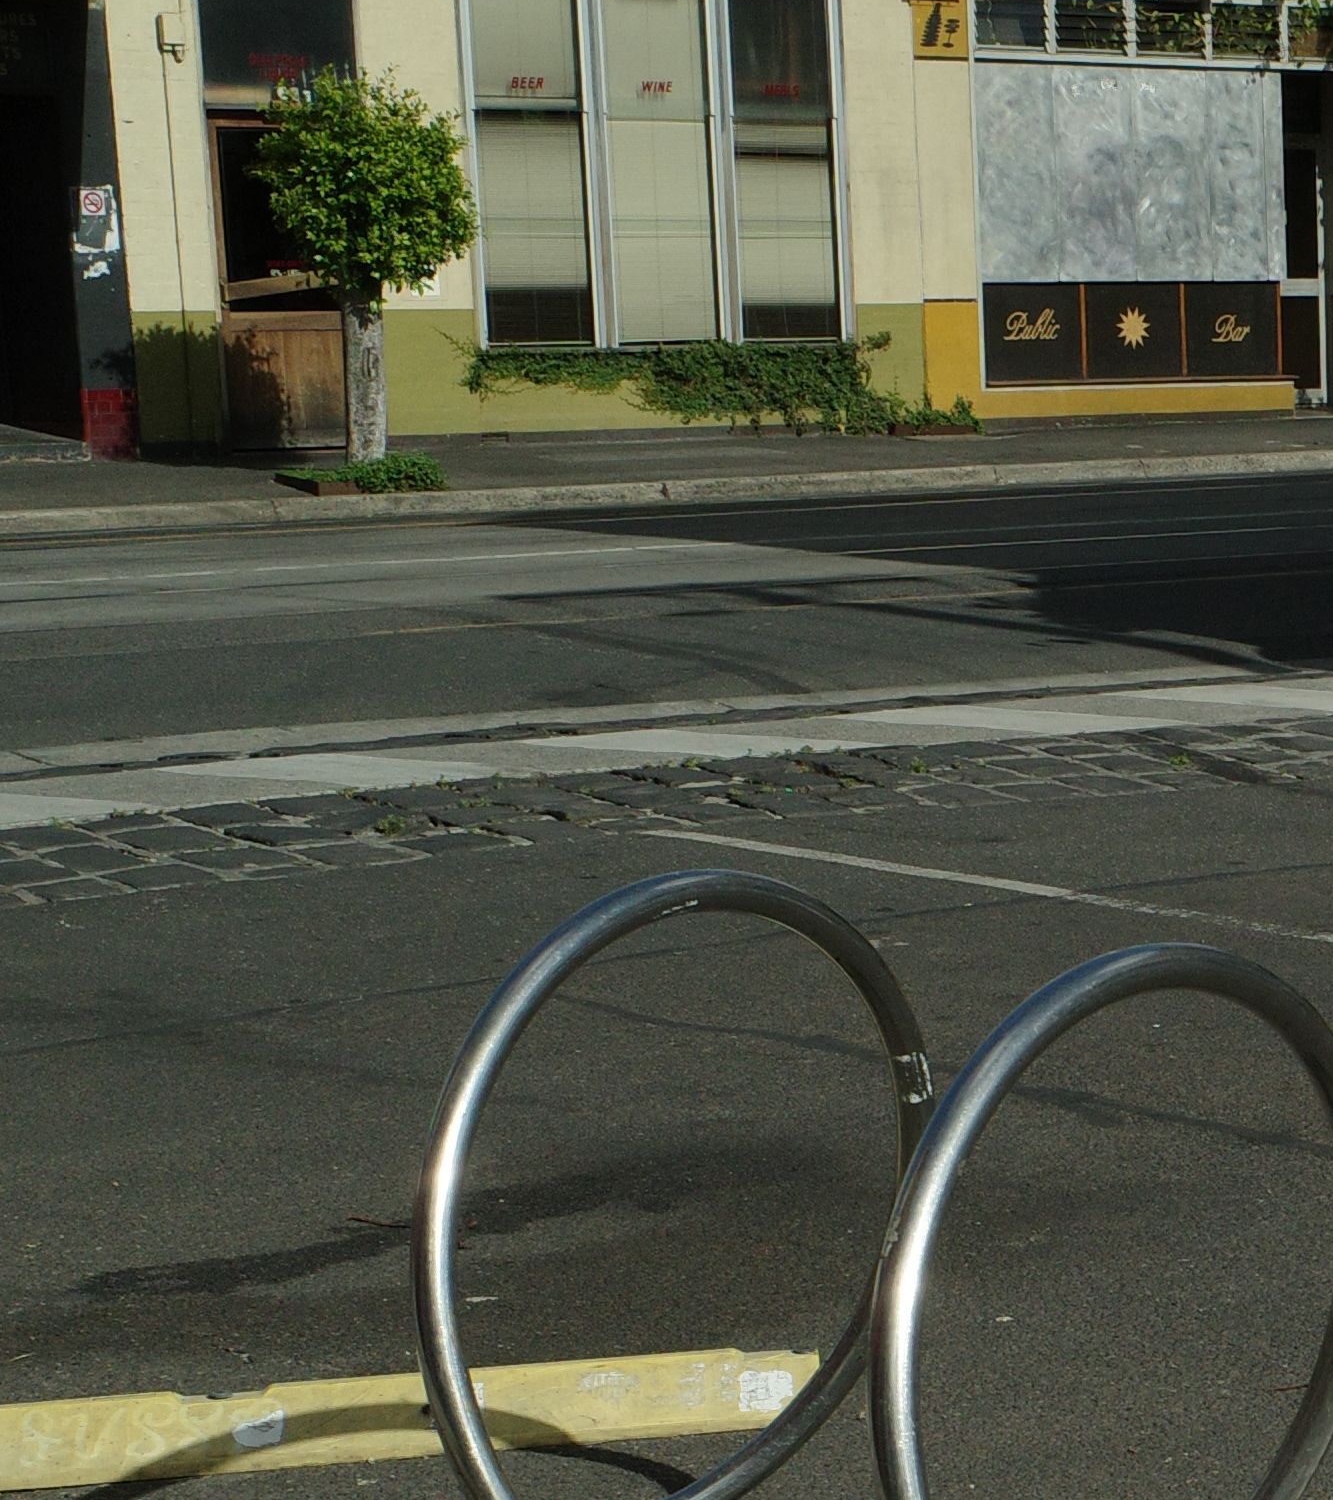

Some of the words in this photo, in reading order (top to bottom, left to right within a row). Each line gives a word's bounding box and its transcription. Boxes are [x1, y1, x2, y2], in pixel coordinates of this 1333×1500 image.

[511, 76, 544, 89] BEER
[641, 81, 673, 93] WINE
[764, 84, 799, 97] MEALS
[1003, 308, 1060, 341] Public
[1211, 314, 1250, 342] Bar
